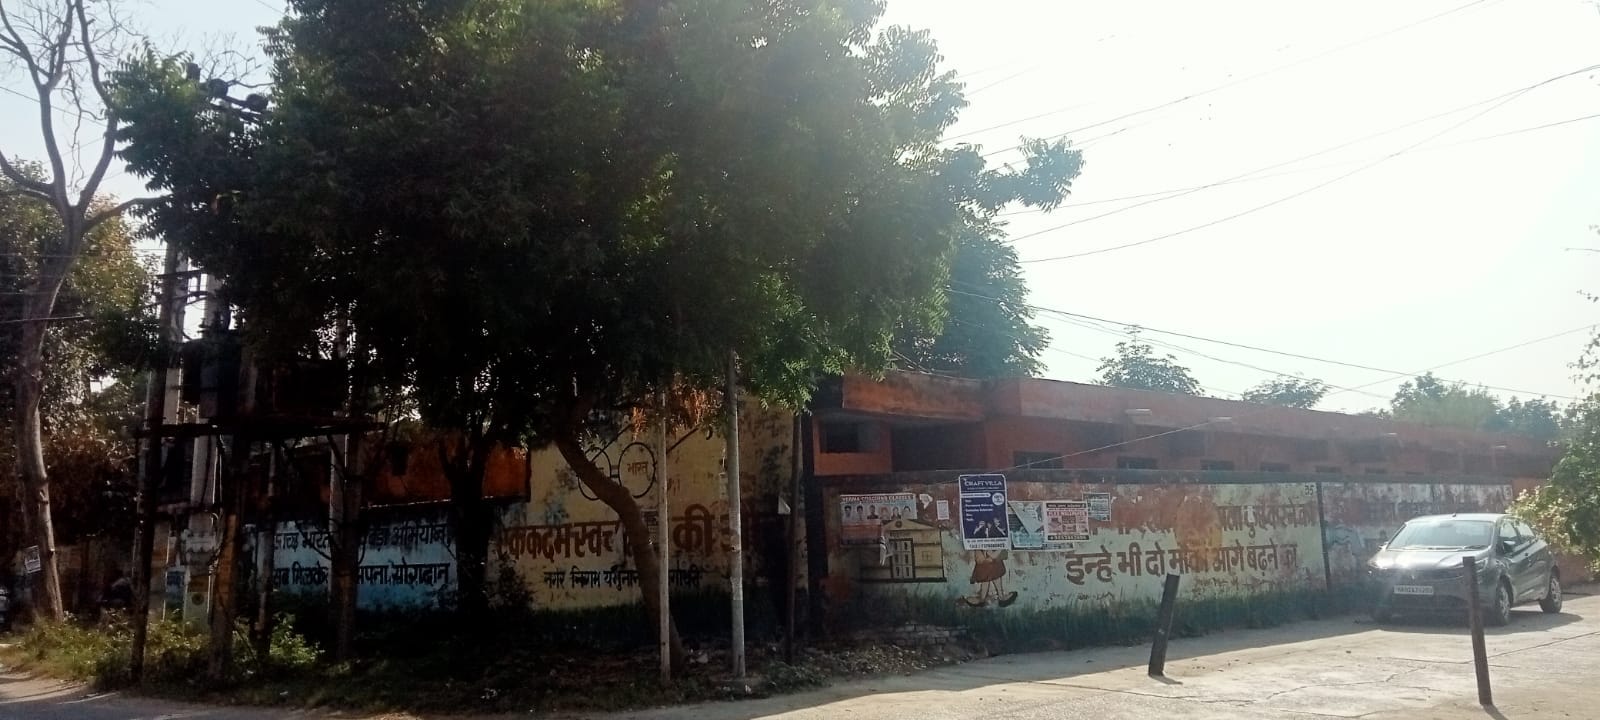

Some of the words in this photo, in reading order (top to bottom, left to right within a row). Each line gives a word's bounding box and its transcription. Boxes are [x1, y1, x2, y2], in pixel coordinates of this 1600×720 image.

[627, 461, 649, 476] भारत
[671, 503, 715, 558] की
[1117, 542, 1142, 576] भी
[1146, 541, 1165, 576] दो
